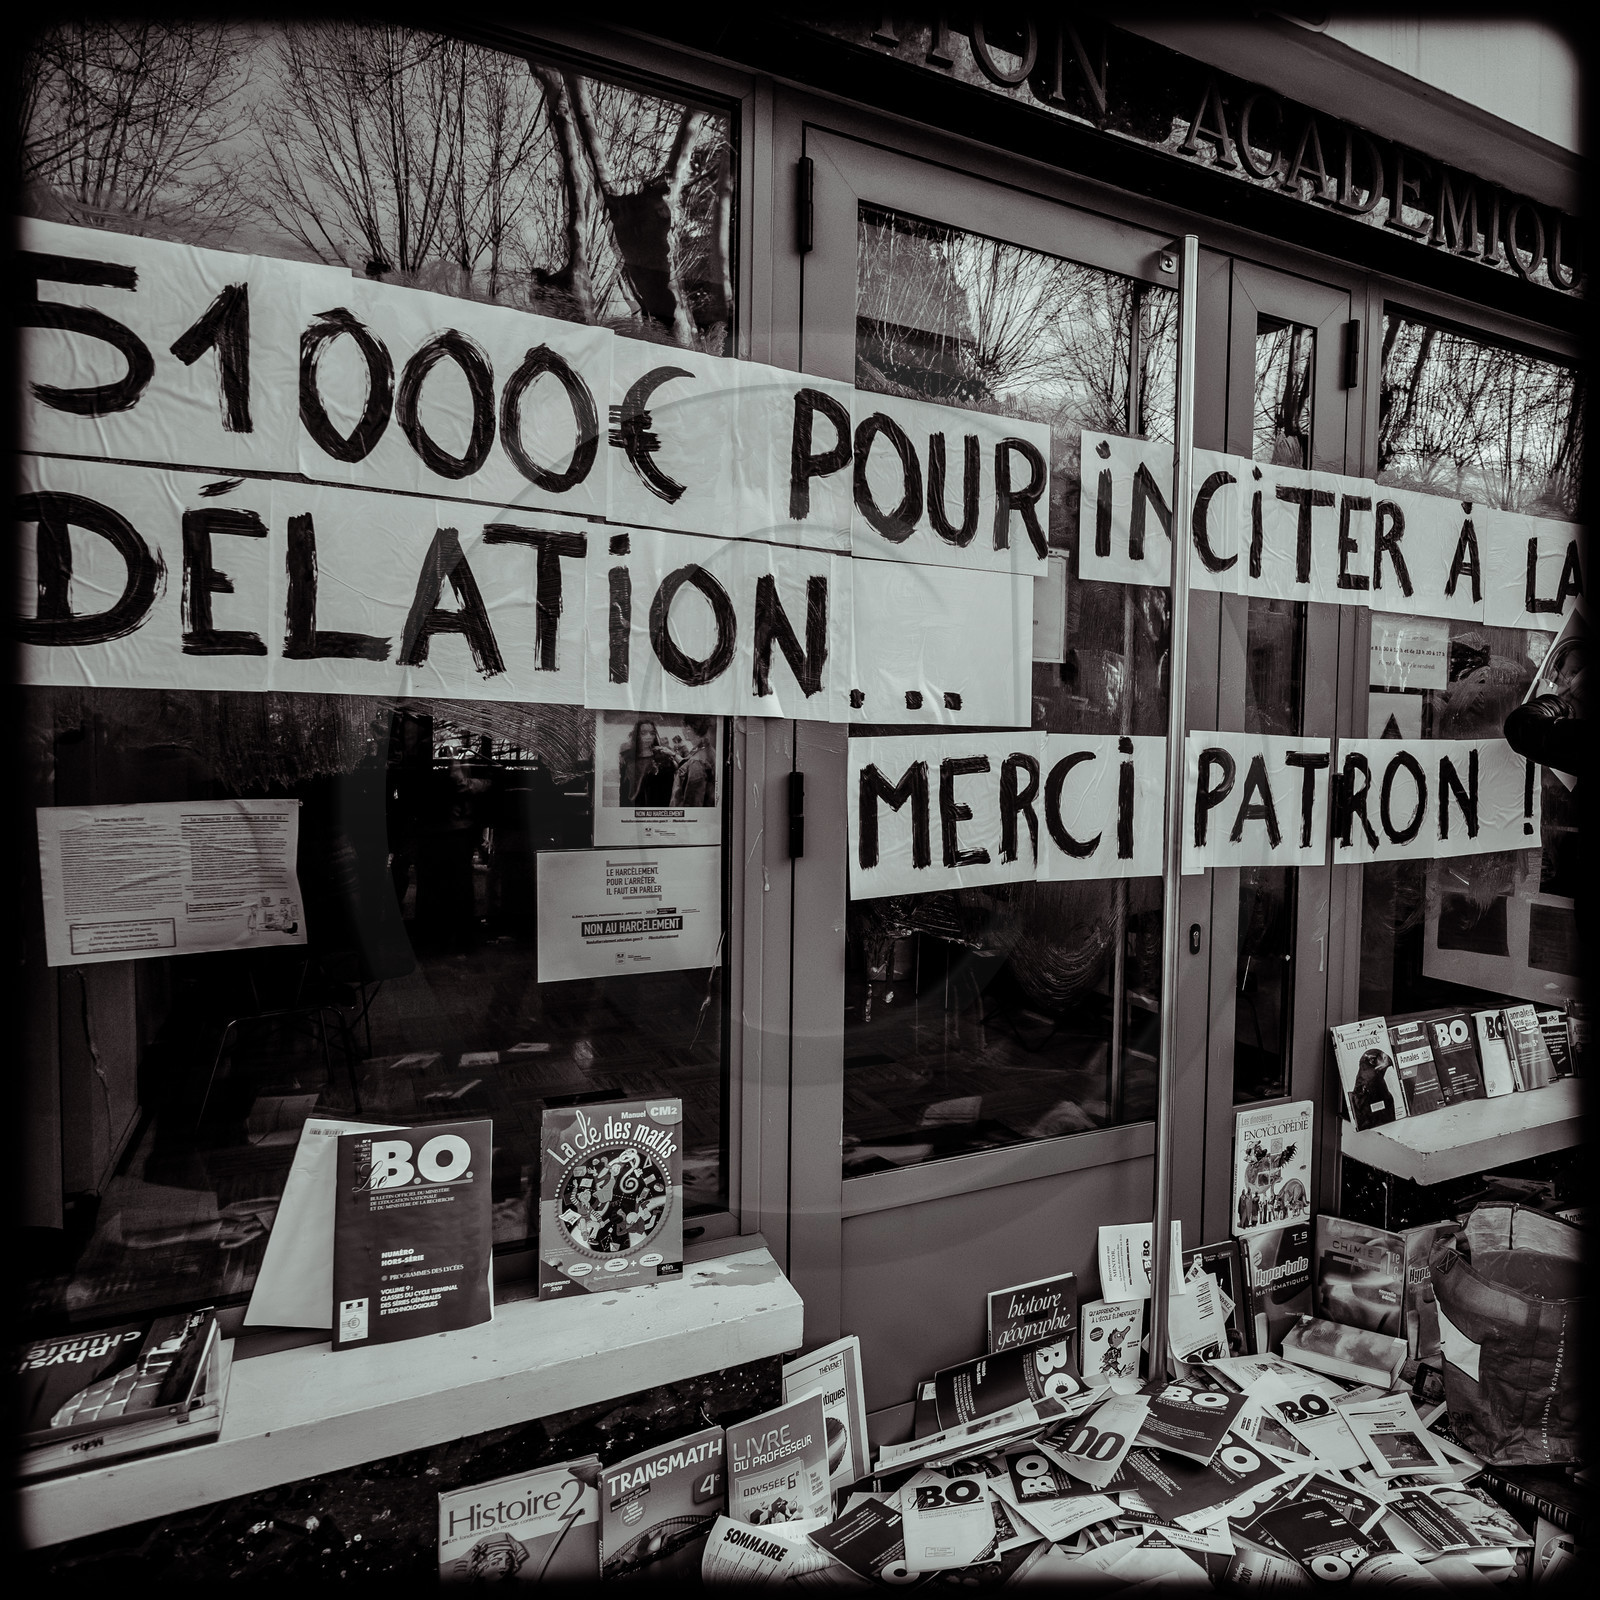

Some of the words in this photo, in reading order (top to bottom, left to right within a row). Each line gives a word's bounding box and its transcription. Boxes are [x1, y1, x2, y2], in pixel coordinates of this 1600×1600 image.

[791, 388, 1049, 560] POUR
[1445, 500, 1484, 604] À
[1526, 537, 1583, 614] LA
[1191, 747, 1479, 852] PATRON
[606, 869, 614, 877] LE
[606, 877, 623, 886] POUR
[606, 887, 613, 895] IL
[614, 887, 628, 895] FAUT
[630, 886, 638, 894] EN
[639, 885, 662, 894] PARLER
[584, 924, 603, 935] NON
[605, 923, 617, 933] AU
[619, 917, 681, 933] HARCÈLEMENT
[1509, 1009, 1534, 1020] annales
[1358, 1035, 1382, 1050] rapace
[1435, 1019, 1471, 1048] B.O.
[1400, 1053, 1420, 1064] Annales
[621, 1110, 646, 1120] Manuel
[650, 1105, 678, 1117] CM2
[547, 1142, 577, 1166] La
[604, 1115, 631, 1141] des
[633, 1123, 678, 1160] maths
[1244, 1119, 1309, 1141] ENCYCLOPÉDIE
[370, 1134, 474, 1190] B.O.
[381, 1248, 415, 1259] NUMÉRO
[1332, 1240, 1375, 1258] CHIMIE
[381, 1254, 425, 1267] HORS-SÉRIE
[389, 1269, 431, 1281] PROGRAMMES
[431, 1267, 443, 1275] DES
[443, 1263, 464, 1272] LYCÉES
[1254, 1256, 1309, 1288] Hyperbole
[380, 1286, 405, 1295] VOLUME
[380, 1293, 404, 1302] CLASSES
[414, 1289, 430, 1297] CYCLE
[431, 1284, 458, 1293] TERMINAL
[541, 1279, 571, 1289] programmes
[1254, 1275, 1310, 1298] MATHÉMATIQUES
[380, 1301, 392, 1309] DES
[1007, 1288, 1062, 1320] histoire
[997, 1310, 1072, 1349] géographie
[26, 1330, 142, 1360] chimie
[818, 1358, 843, 1375] THÉVENET
[823, 1387, 846, 1406] tiques
[1157, 1385, 1229, 1409] B.O.
[733, 1424, 792, 1461] LIVRE
[733, 1459, 749, 1473] DU
[752, 1434, 813, 1468] PROFESSEUR
[607, 1438, 722, 1498] TRANSMATH
[743, 1476, 786, 1498] ODYSSÉE
[915, 1479, 984, 1509] B.O.
[557, 1478, 586, 1521] 2
[449, 1490, 562, 1537] Histoire
[723, 1527, 789, 1563] SOMMAIRE
